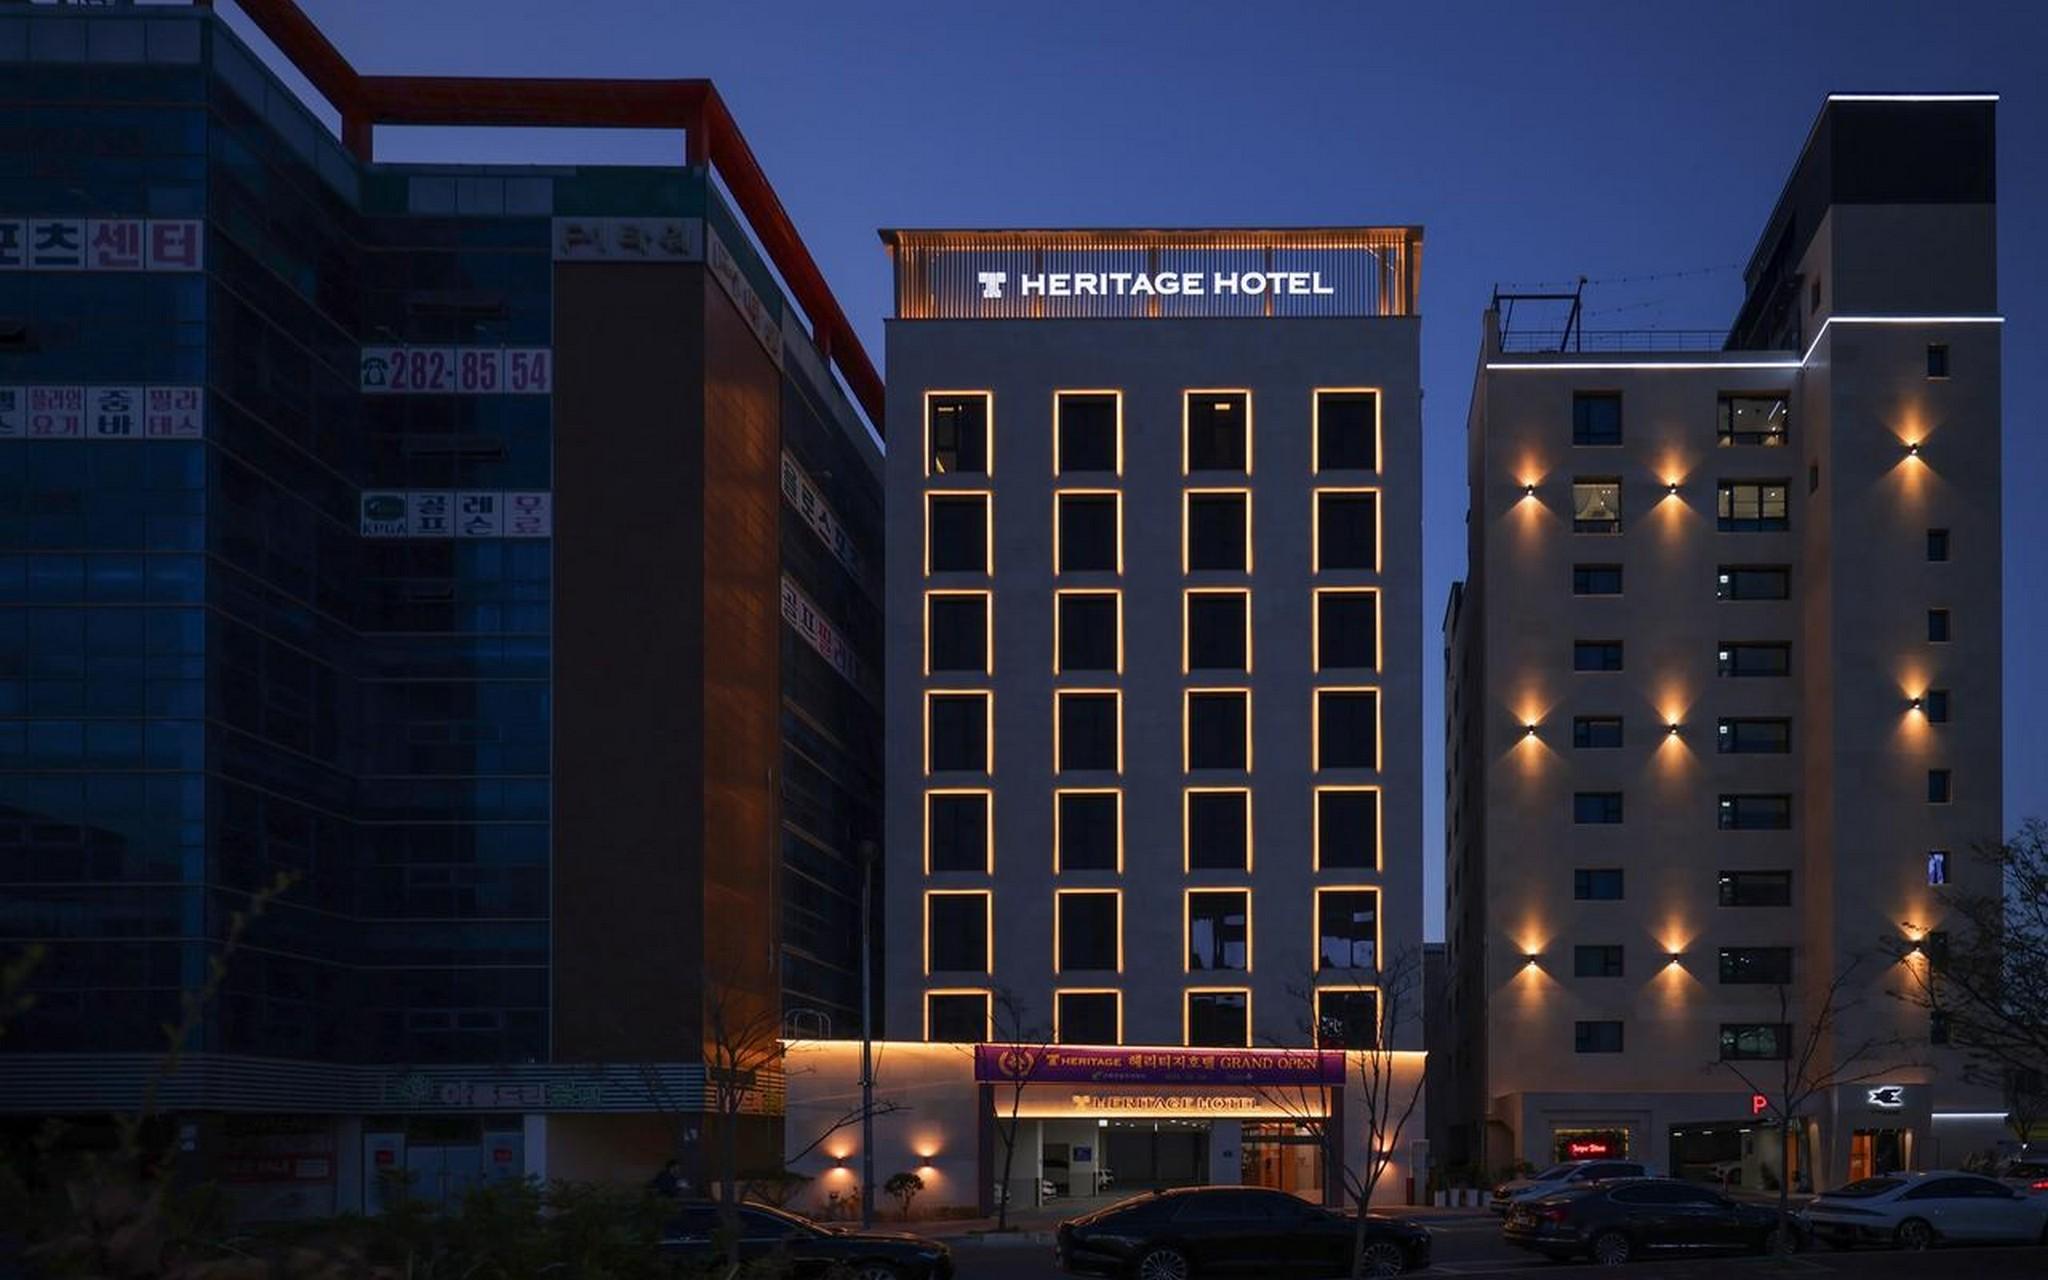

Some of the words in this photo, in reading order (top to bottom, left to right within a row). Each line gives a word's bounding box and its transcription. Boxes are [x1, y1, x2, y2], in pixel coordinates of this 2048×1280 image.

[1021, 271, 1204, 297] HERITAGE
[1213, 271, 1334, 295] HOTEL
[1061, 1056, 1122, 1067] HERITAGE
[1220, 1055, 1273, 1069] GRAND
[1277, 1057, 1318, 1069] OPEN
[1093, 1095, 1191, 1110] HERITAGE
[1197, 1095, 1262, 1110] HOTEL
[1751, 1093, 1768, 1115] P
